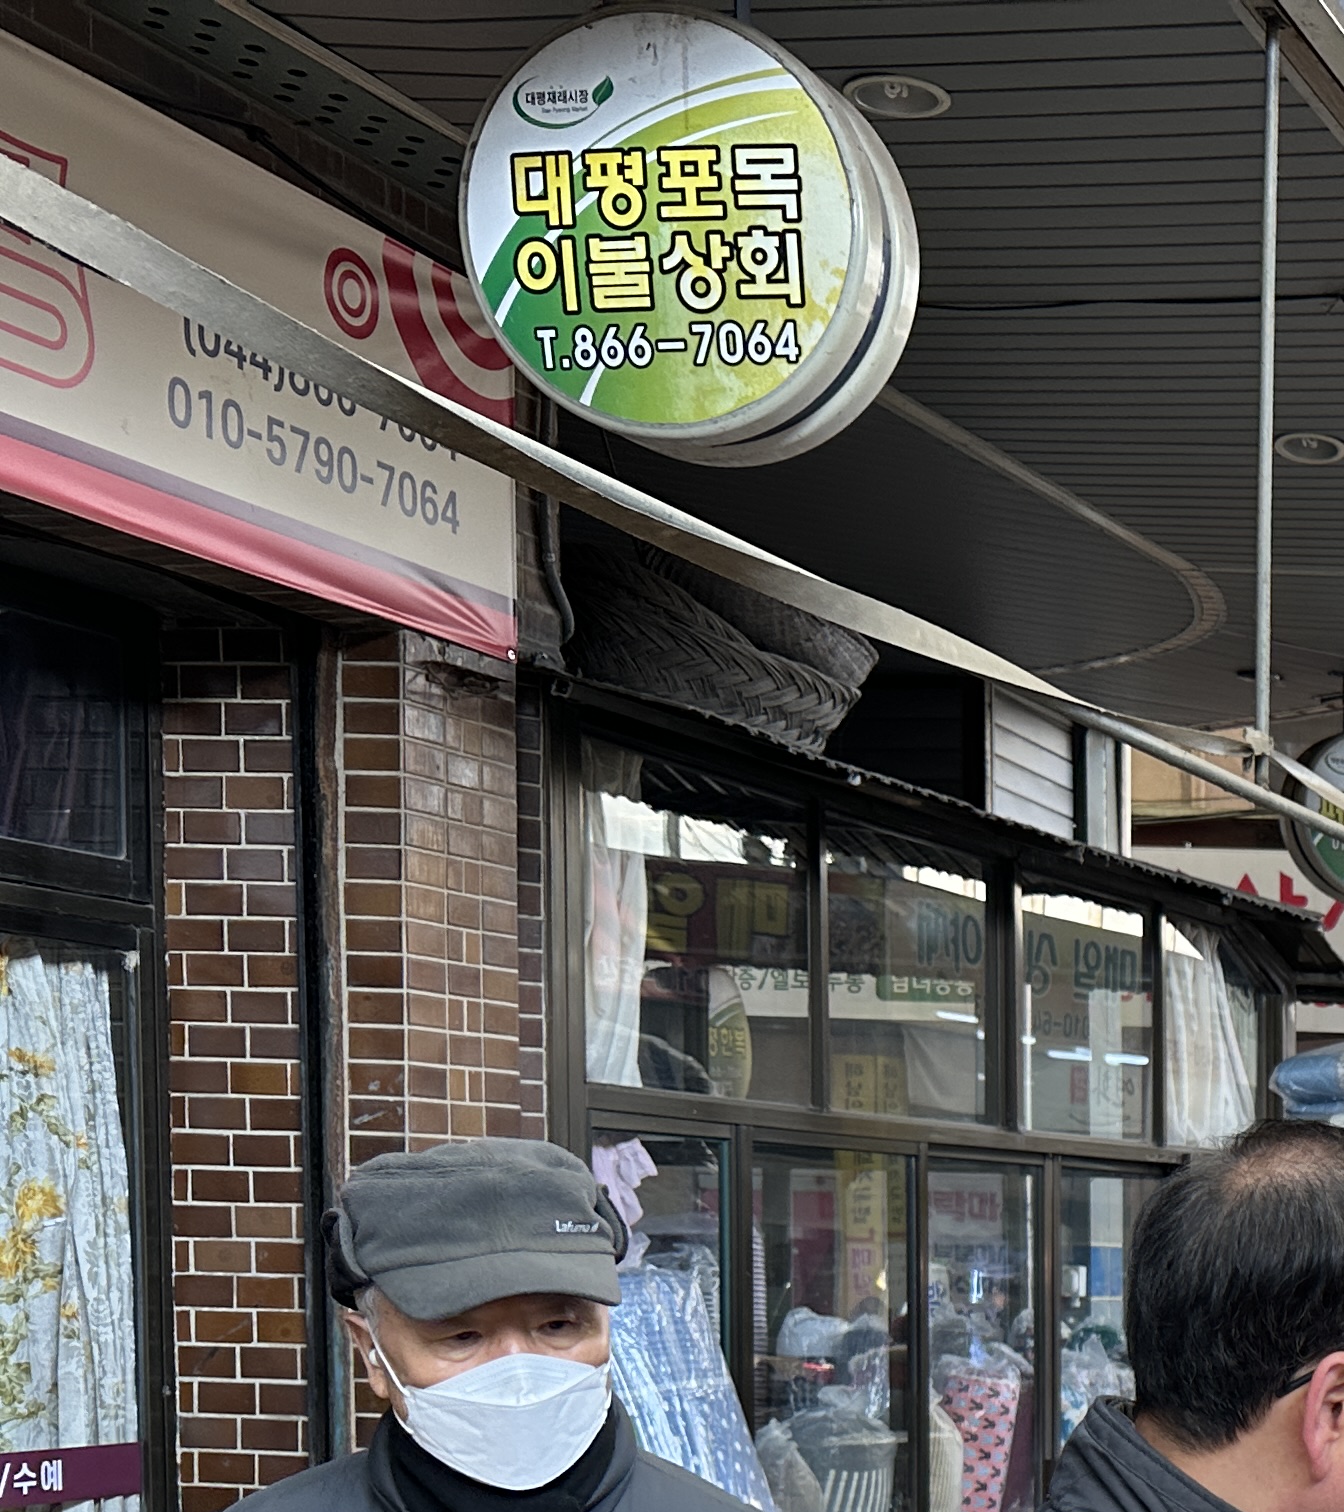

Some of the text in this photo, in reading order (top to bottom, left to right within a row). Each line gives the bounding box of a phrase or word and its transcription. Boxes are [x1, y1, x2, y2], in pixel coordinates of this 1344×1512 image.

[511, 144, 802, 231] 대평포목
[515, 227, 804, 315] 이불상회
[536, 321, 800, 370] T.866-7064
[168, 376, 460, 534] 010-5790-7064
